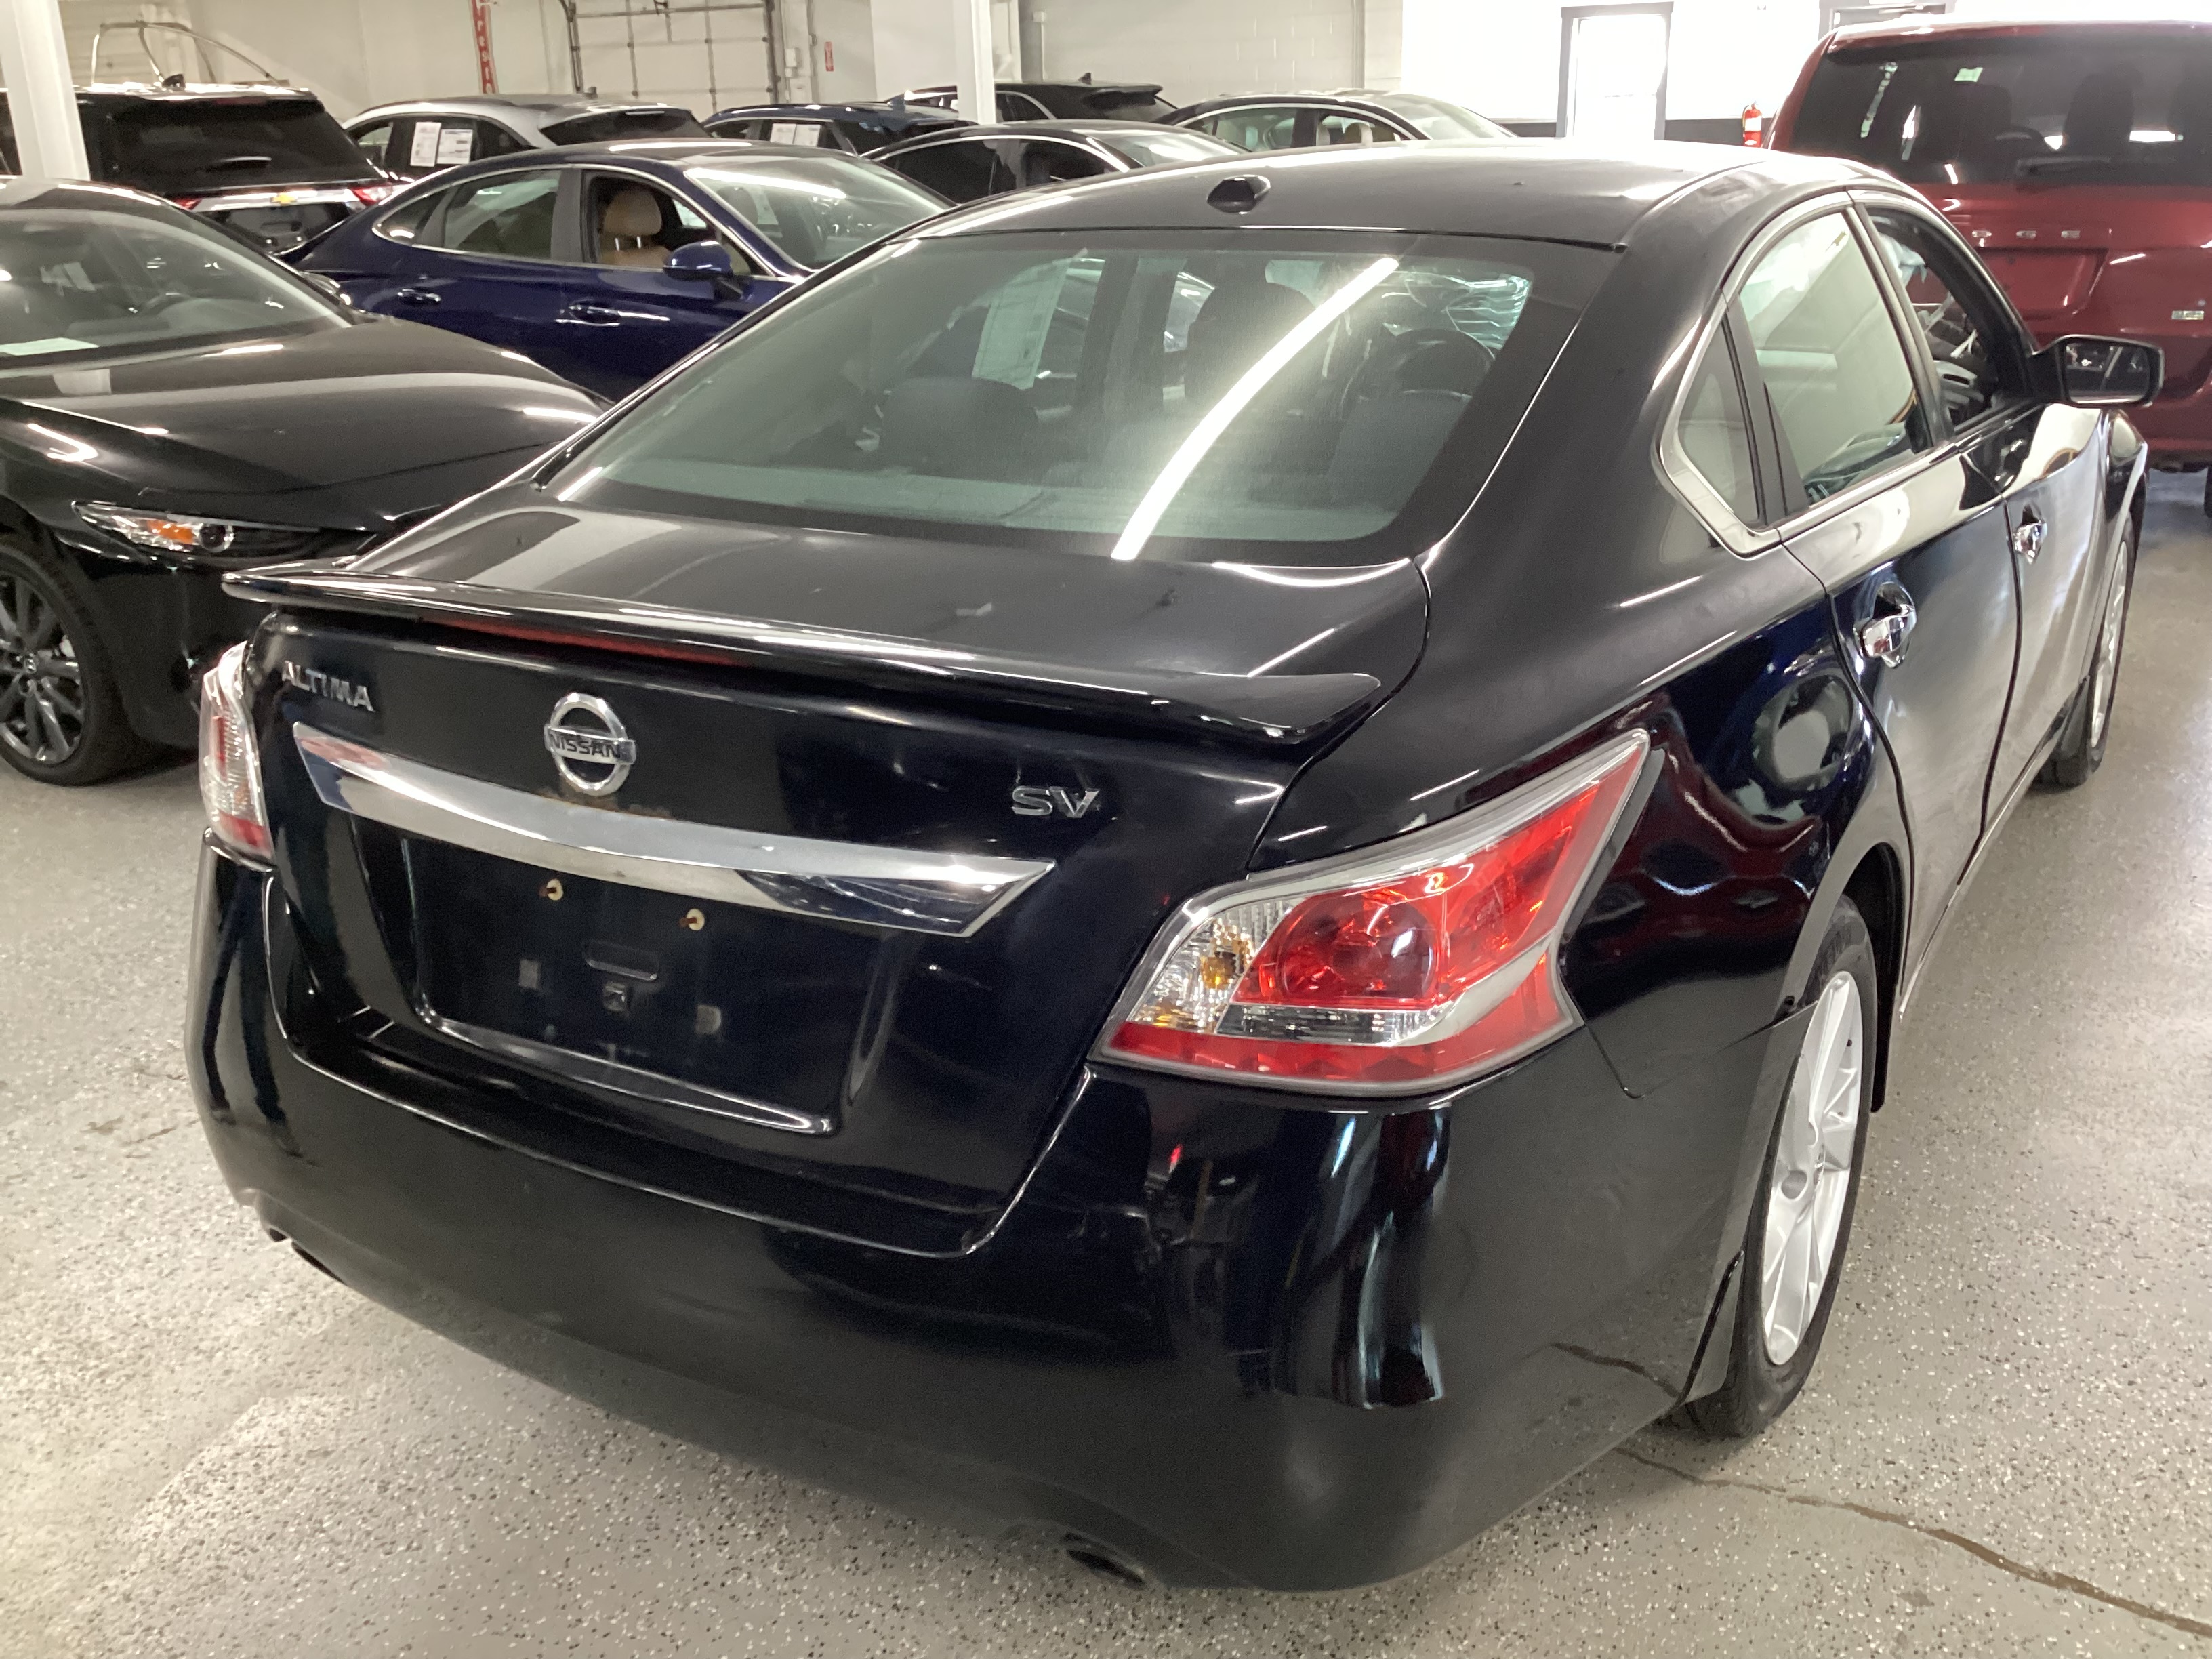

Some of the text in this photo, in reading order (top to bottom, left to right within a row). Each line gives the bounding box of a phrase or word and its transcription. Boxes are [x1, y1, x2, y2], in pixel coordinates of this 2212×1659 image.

[281, 660, 375, 712] ALTIMA
[550, 731, 621, 759] NISSAN
[1011, 785, 1100, 818] SV
